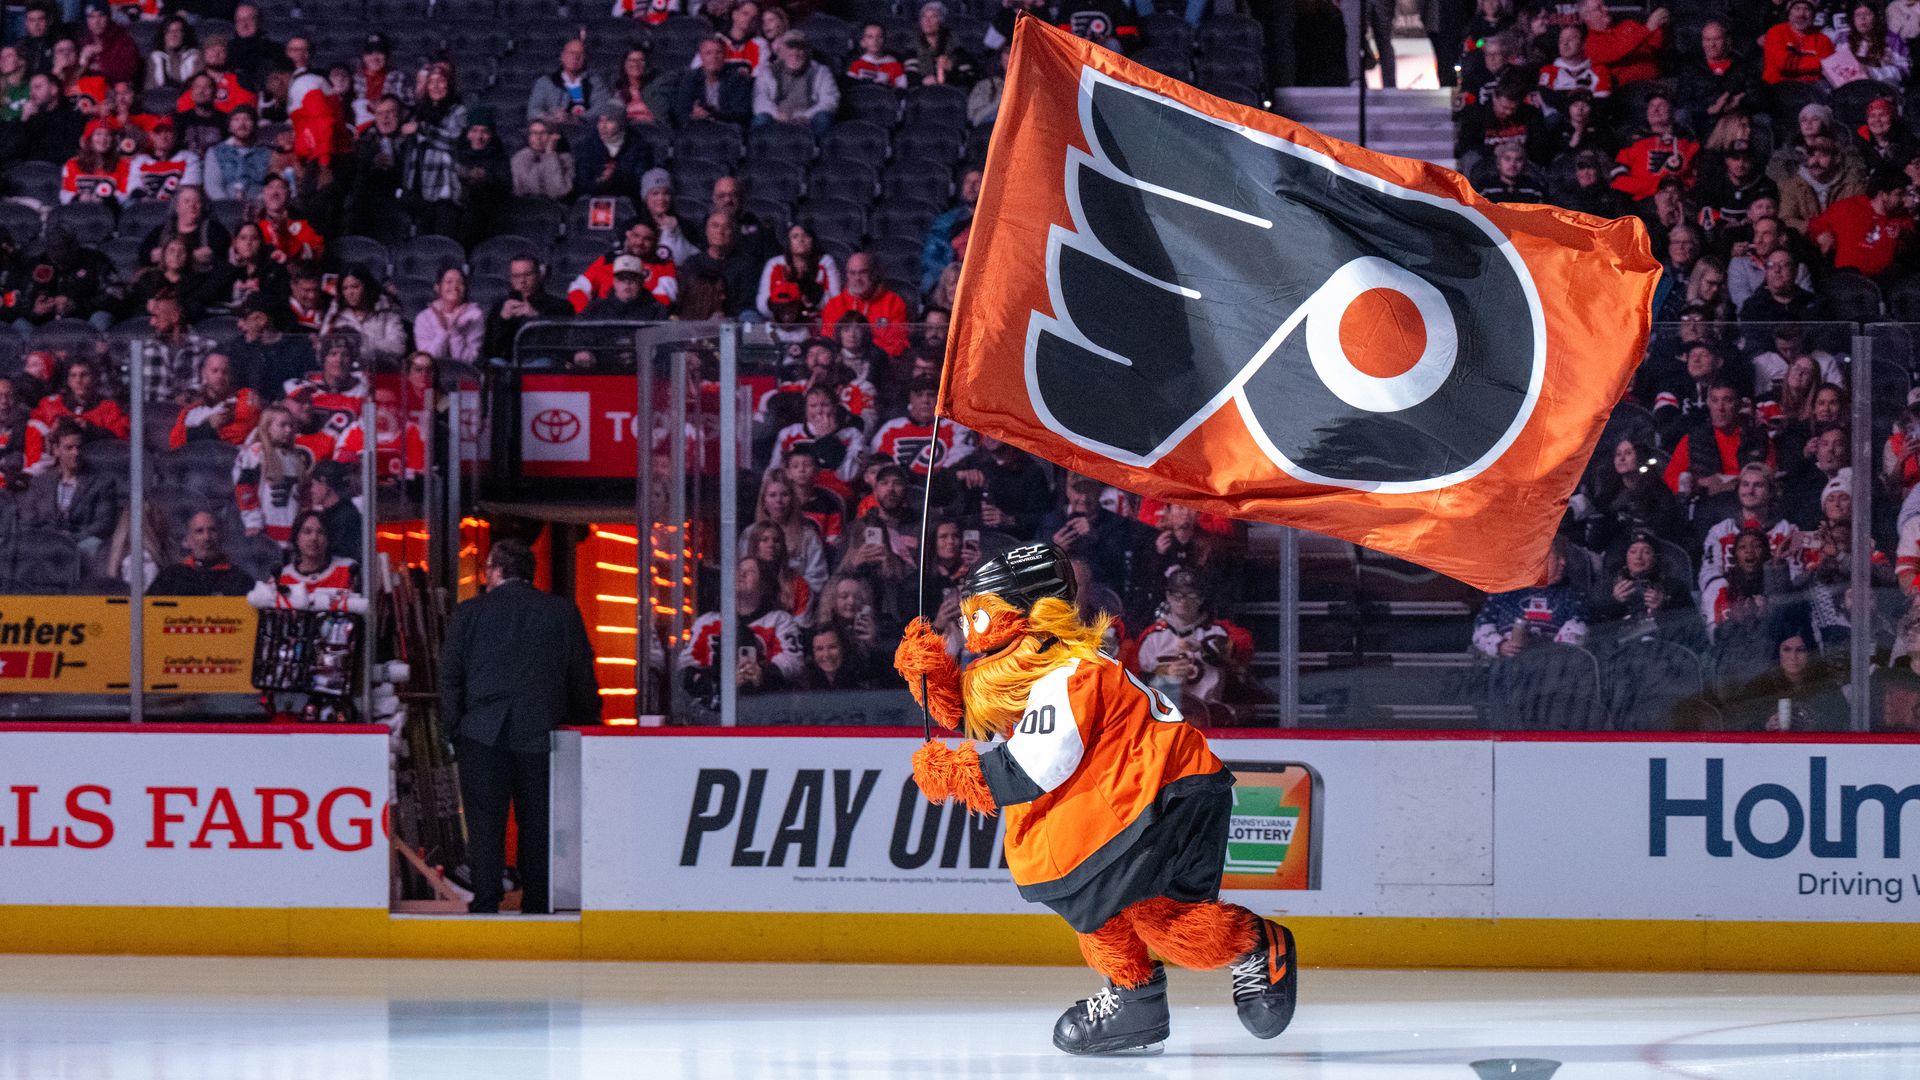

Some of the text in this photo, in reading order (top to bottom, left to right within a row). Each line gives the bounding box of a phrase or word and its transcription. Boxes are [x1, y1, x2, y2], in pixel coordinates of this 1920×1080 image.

[605, 411, 639, 442] T
[1010, 555, 1043, 565] CHEVROLET
[0, 611, 85, 645] nters
[0, 785, 390, 851] LS FARG
[679, 768, 1009, 869] PLAY ON
[1798, 871, 1902, 903] Driving
